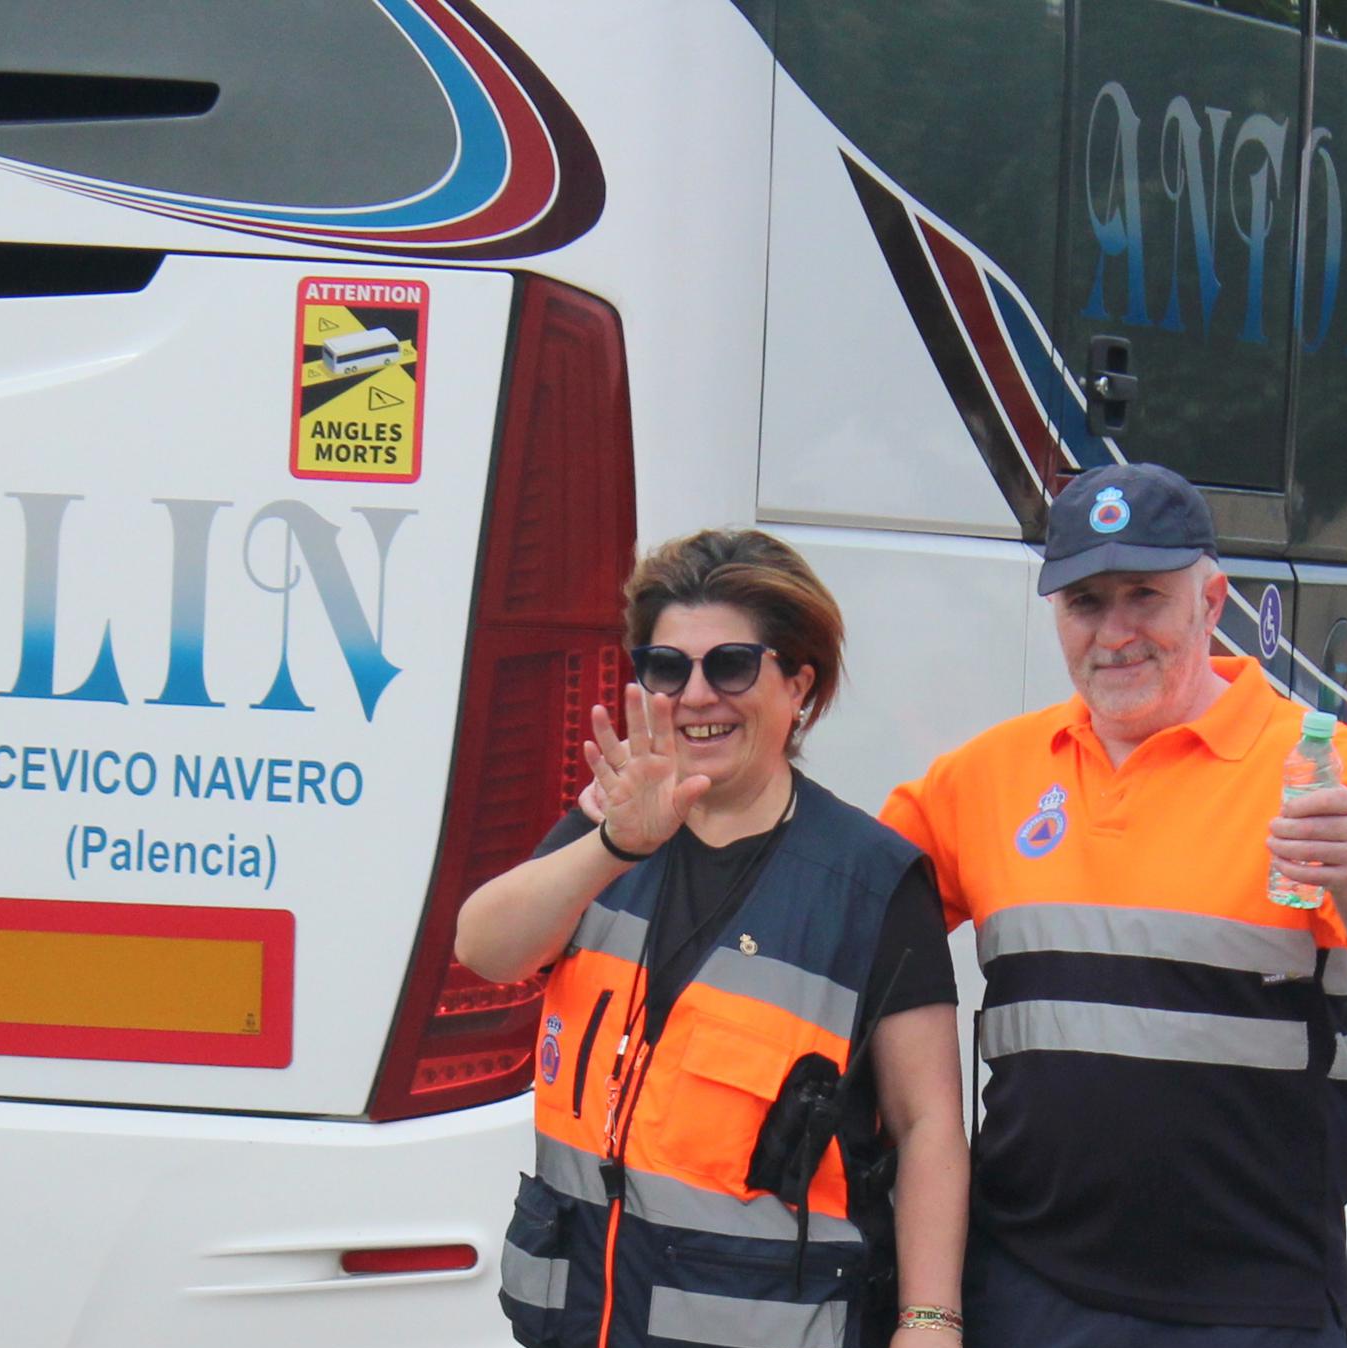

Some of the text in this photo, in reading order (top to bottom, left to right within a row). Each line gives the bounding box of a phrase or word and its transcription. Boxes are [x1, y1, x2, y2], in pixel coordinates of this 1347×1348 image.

[305, 283, 422, 304] ATTENTION
[311, 420, 403, 442] ANGLES
[315, 443, 398, 464] MORTS
[174, 754, 364, 806] NAVERO
[65, 825, 278, 889] (Palencia)
